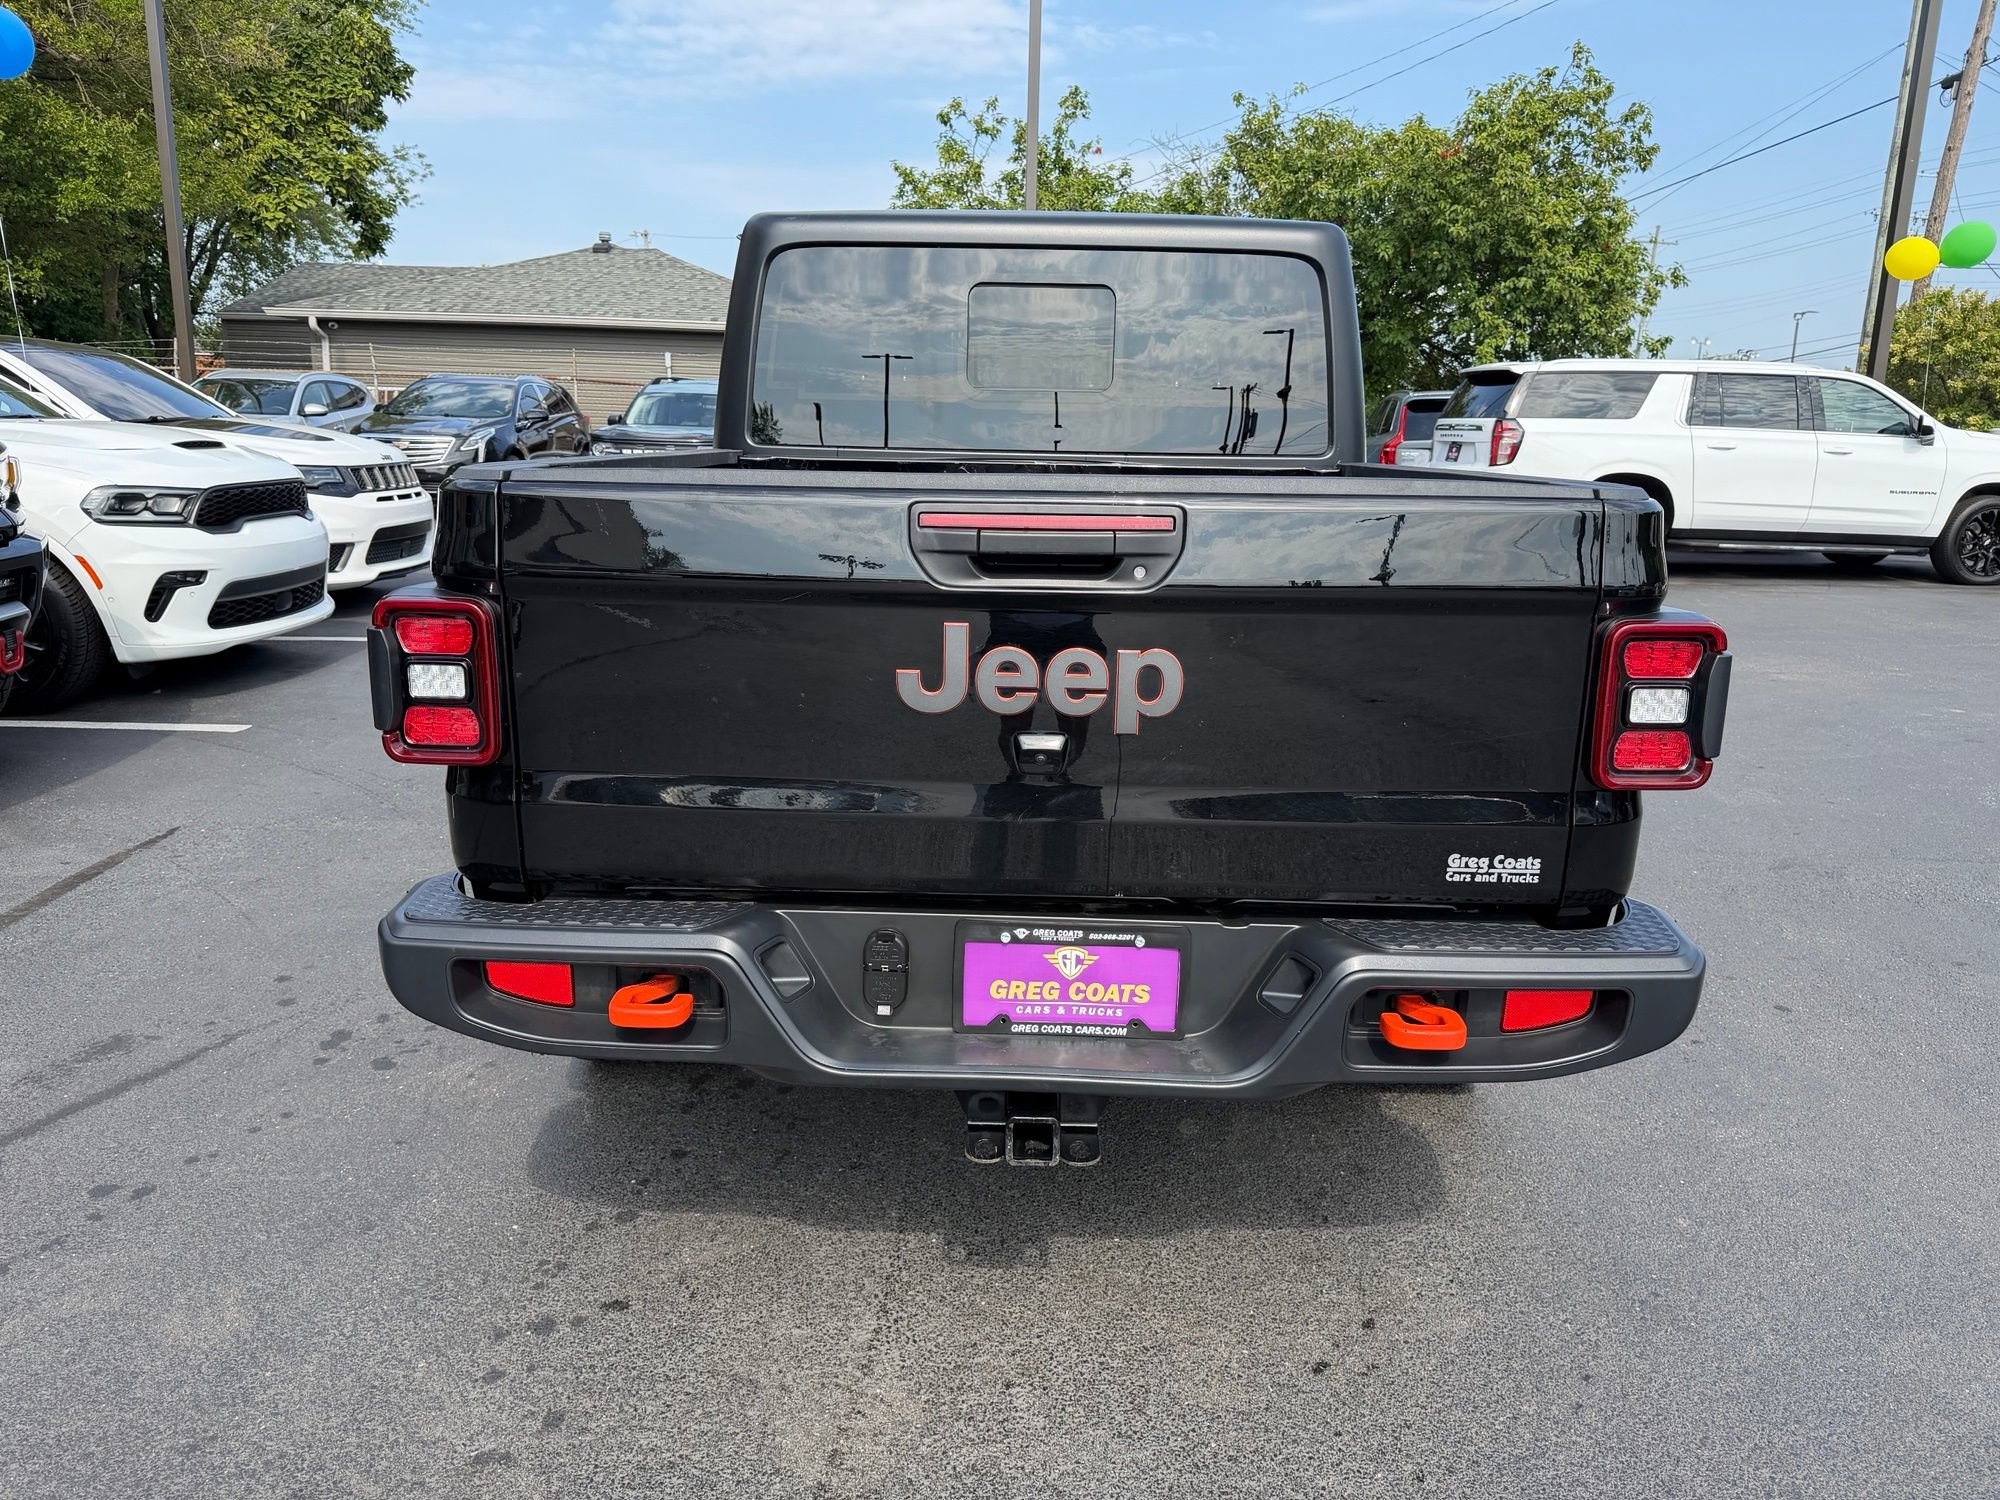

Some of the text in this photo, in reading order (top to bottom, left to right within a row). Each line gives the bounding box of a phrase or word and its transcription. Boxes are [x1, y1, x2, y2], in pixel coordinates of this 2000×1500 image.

[895, 622, 1184, 736] Jeep
[1447, 853, 1542, 874] Greg Coats
[1445, 871, 1540, 884] Cars and Trucks
[1032, 928, 1084, 938] GREG COATS
[989, 979, 1152, 1004] GREG COATS
[1015, 1005, 1124, 1017] CARS & TRUCKS
[1010, 1024, 1128, 1037] GREG COATS CARS.COM
